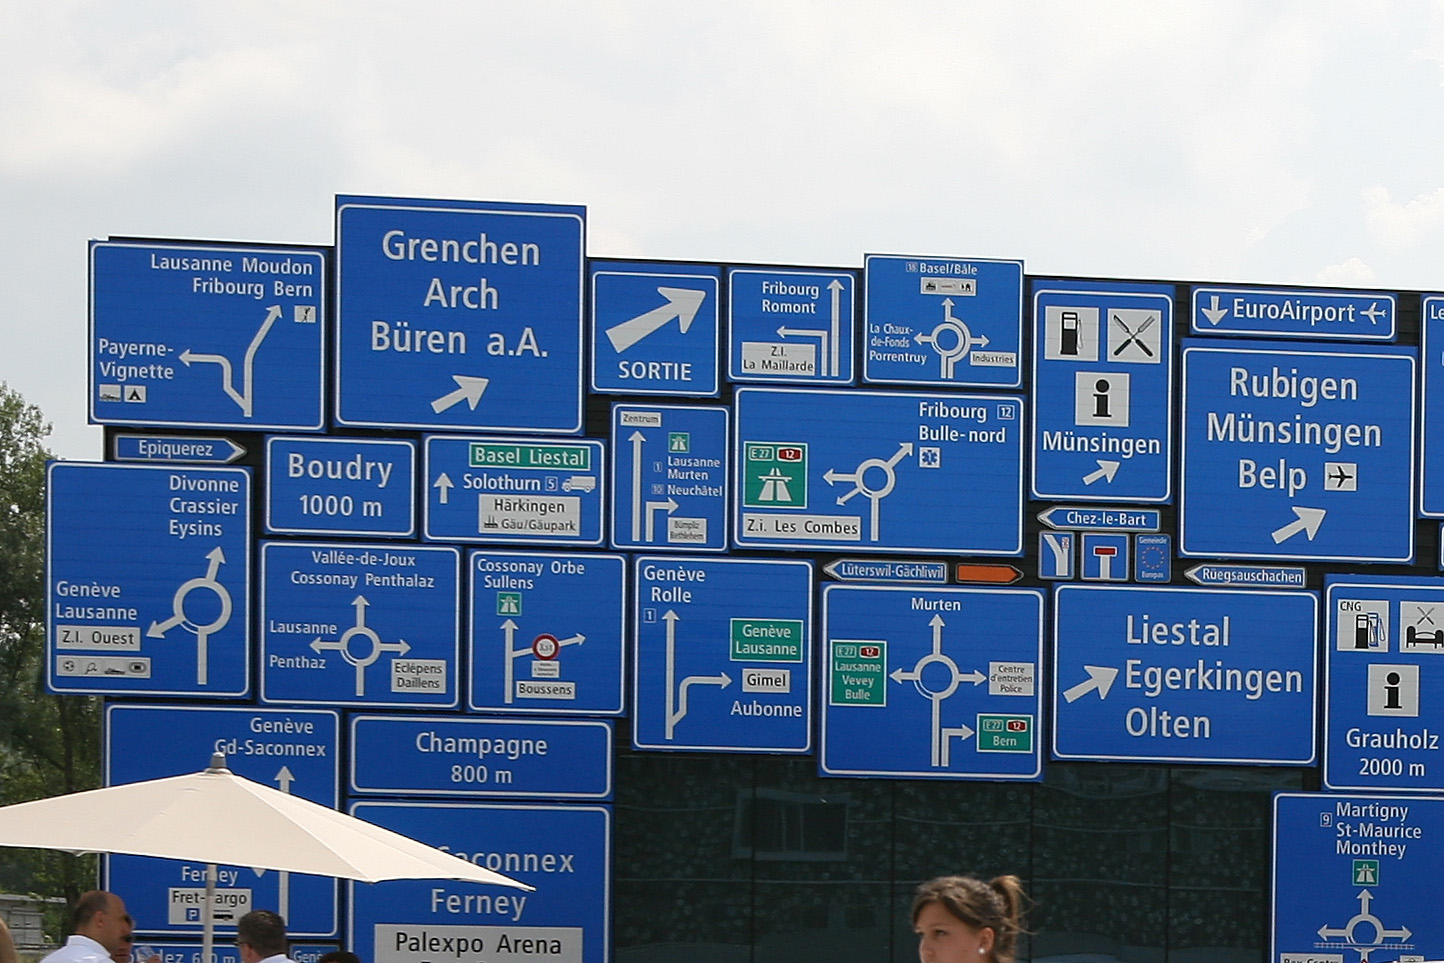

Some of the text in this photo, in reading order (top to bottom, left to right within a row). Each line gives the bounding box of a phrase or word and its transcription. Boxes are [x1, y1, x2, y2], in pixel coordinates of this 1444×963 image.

[383, 231, 539, 265] Grenchen
[152, 254, 312, 275] Lausanne Moudon
[194, 277, 312, 299] Fribourg Bern
[424, 278, 497, 309] Arch
[763, 281, 819, 299] Fribourg
[763, 299, 815, 314] Romont
[1234, 299, 1355, 326] EuroAirport
[372, 321, 547, 357] Büren a.A.
[99, 338, 173, 359] Payerne-
[870, 350, 927, 365] Porrentruy
[100, 362, 173, 381] Vignette
[619, 361, 691, 380] SORTIE
[1231, 367, 1356, 407] Rubigen
[920, 425, 1005, 442] Bulle-nord
[1208, 413, 1380, 453] Münsingen
[139, 440, 213, 456] Epiquerez
[1043, 431, 1159, 458] Münsingen
[476, 447, 583, 465] Basel Liestal
[289, 453, 392, 487] Boudry
[1240, 459, 1306, 497] Belp
[170, 475, 238, 492] Divonne
[668, 485, 722, 496] Neuchâtel
[170, 498, 238, 514] Crassier
[495, 499, 564, 516] Härkingen
[170, 520, 222, 539] Eysins
[501, 519, 576, 533] Gäu/Gäupark
[312, 550, 415, 566] Vallée-de-Joux
[291, 571, 434, 588] Cossonay Penthalaz
[842, 563, 943, 578] Lüterswil-Gächliwil
[1203, 568, 1301, 582] Rüegsauschachen
[57, 581, 120, 597] Genève
[485, 575, 533, 589] Sullens
[652, 587, 691, 602] Rolle
[1127, 615, 1228, 646] Liestal
[270, 655, 326, 669] Penthaz
[395, 663, 442, 676] Eclépens
[999, 665, 1025, 673] Centre
[397, 677, 440, 688] Daillens
[1000, 684, 1022, 693] Police
[1127, 660, 1301, 699] Egerkingen
[519, 683, 571, 695] Boussens
[731, 700, 802, 717] Aubonne
[1126, 707, 1209, 738] Olten
[416, 732, 547, 759] Champagne
[1347, 728, 1438, 749] Grauholz
[1337, 822, 1421, 838] St-Maurice
[1337, 840, 1406, 859] Monthey
[436, 846, 574, 874] connex
[182, 866, 238, 886] Ferey
[172, 891, 247, 907] Fret-argo
[432, 889, 526, 921] Ferney
[397, 932, 561, 958] Palexpo Arena
